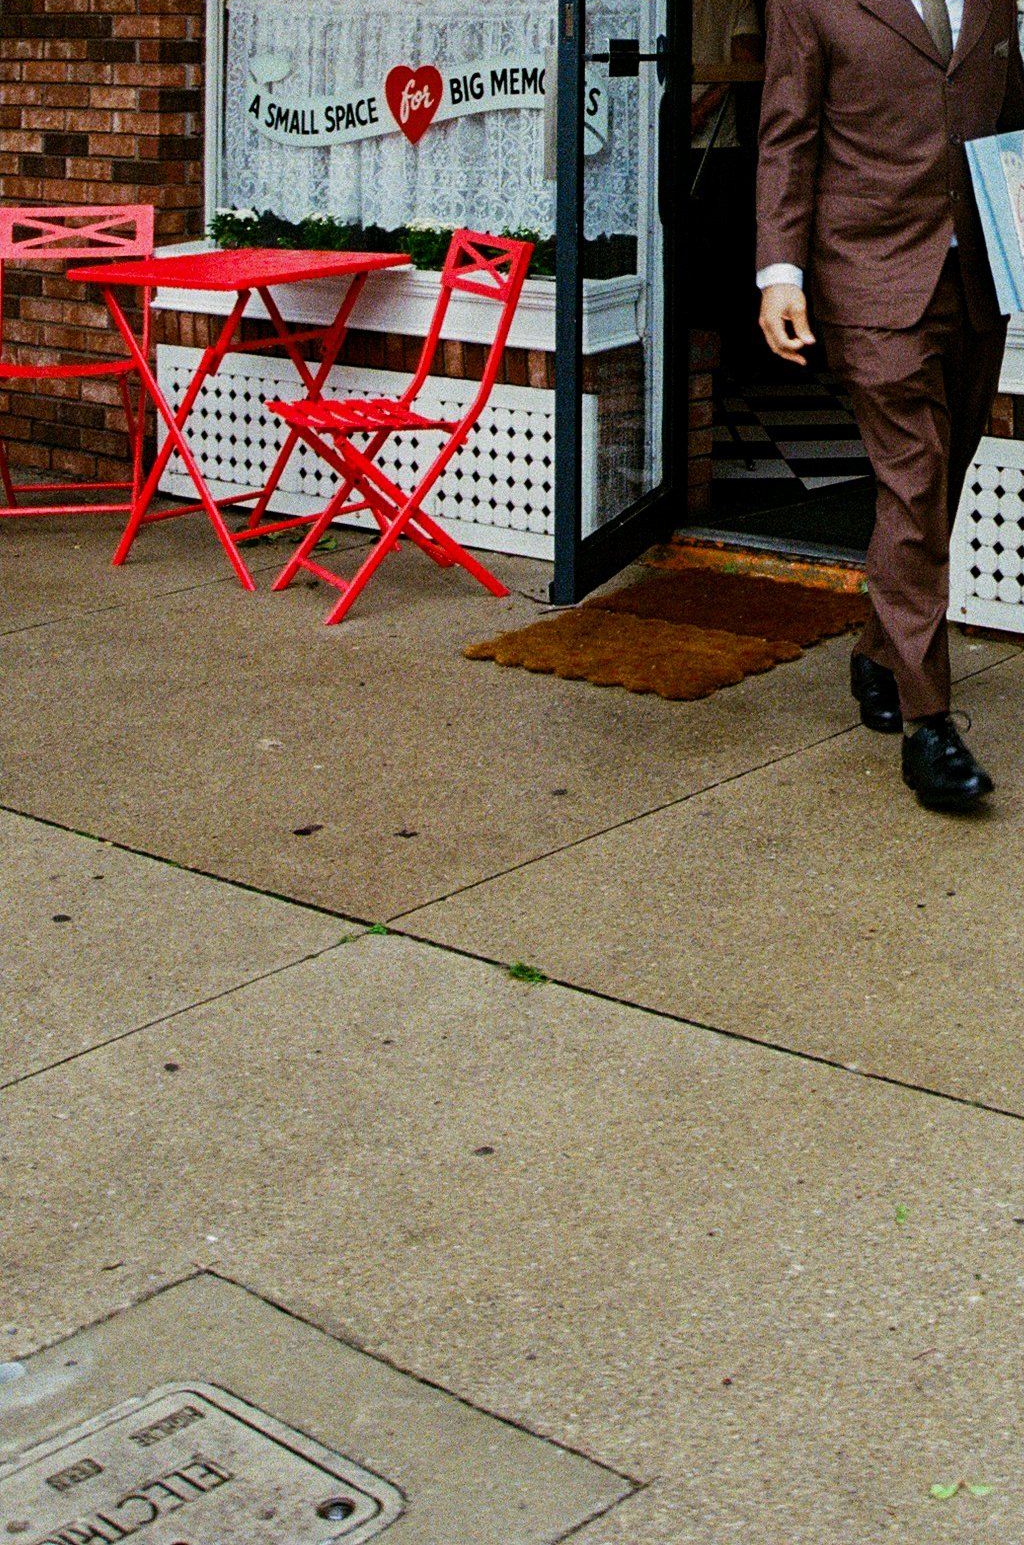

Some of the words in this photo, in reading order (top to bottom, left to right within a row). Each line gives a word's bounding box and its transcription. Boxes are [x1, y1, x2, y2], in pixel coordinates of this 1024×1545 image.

[248, 94, 261, 117] A
[264, 105, 319, 135] SMALL
[325, 97, 379, 132] SPACE
[400, 78, 435, 123] for
[450, 72, 484, 105] BIG
[33, 1455, 234, 1545] ELECTRI
